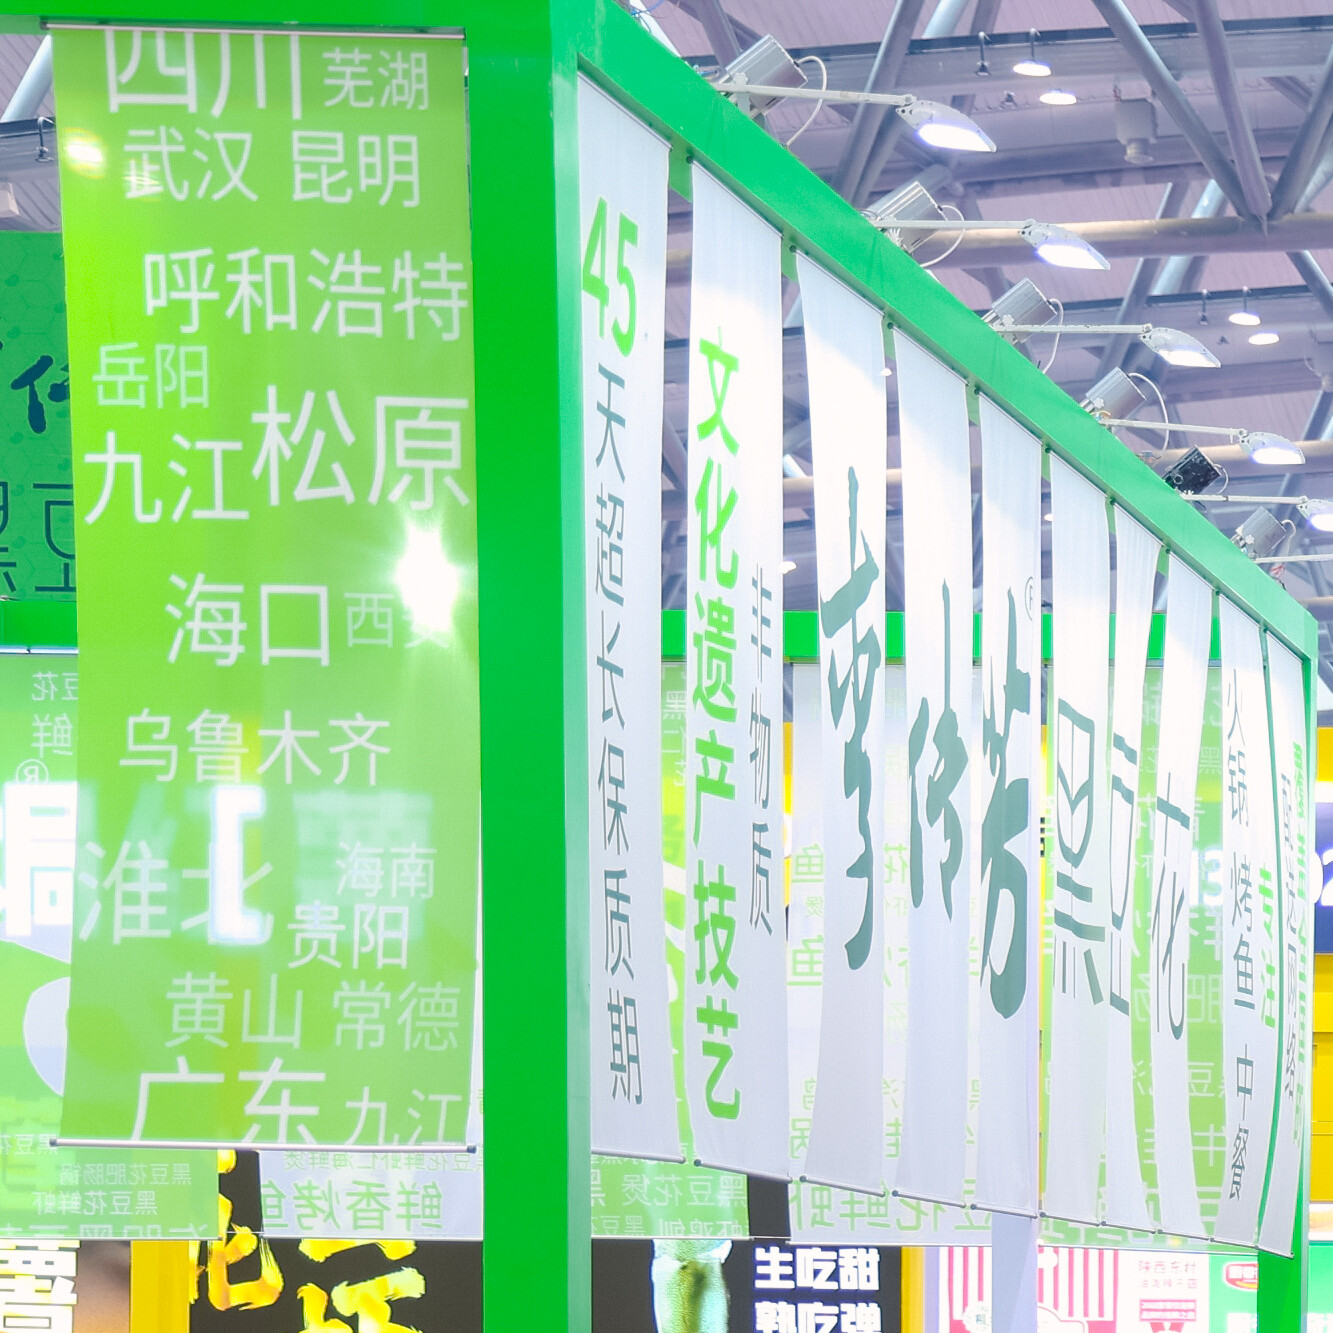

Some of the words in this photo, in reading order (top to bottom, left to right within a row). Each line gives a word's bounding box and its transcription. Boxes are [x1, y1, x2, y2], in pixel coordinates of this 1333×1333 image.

[104, 30, 302, 119] 四川
[322, 48, 429, 111] 芜湖
[124, 127, 257, 201] 武汉
[291, 130, 420, 207] 昆明
[143, 247, 469, 342] 呼和浩特
[92, 342, 210, 410] 岳阳
[83, 431, 250, 525] 九江
[251, 385, 470, 511] 松原
[165, 572, 331, 668] 海口
[119, 708, 391, 786] 乌鲁木齐
[694, 325, 740, 1121] 文化遗产技艺
[335, 842, 437, 899] 海南
[288, 901, 410, 970] 贵阳
[165, 972, 302, 1050] 黄山
[332, 979, 461, 1053] 常德
[130, 1055, 326, 1146] 广东
[754, 1246, 881, 1292] 生吃甜
